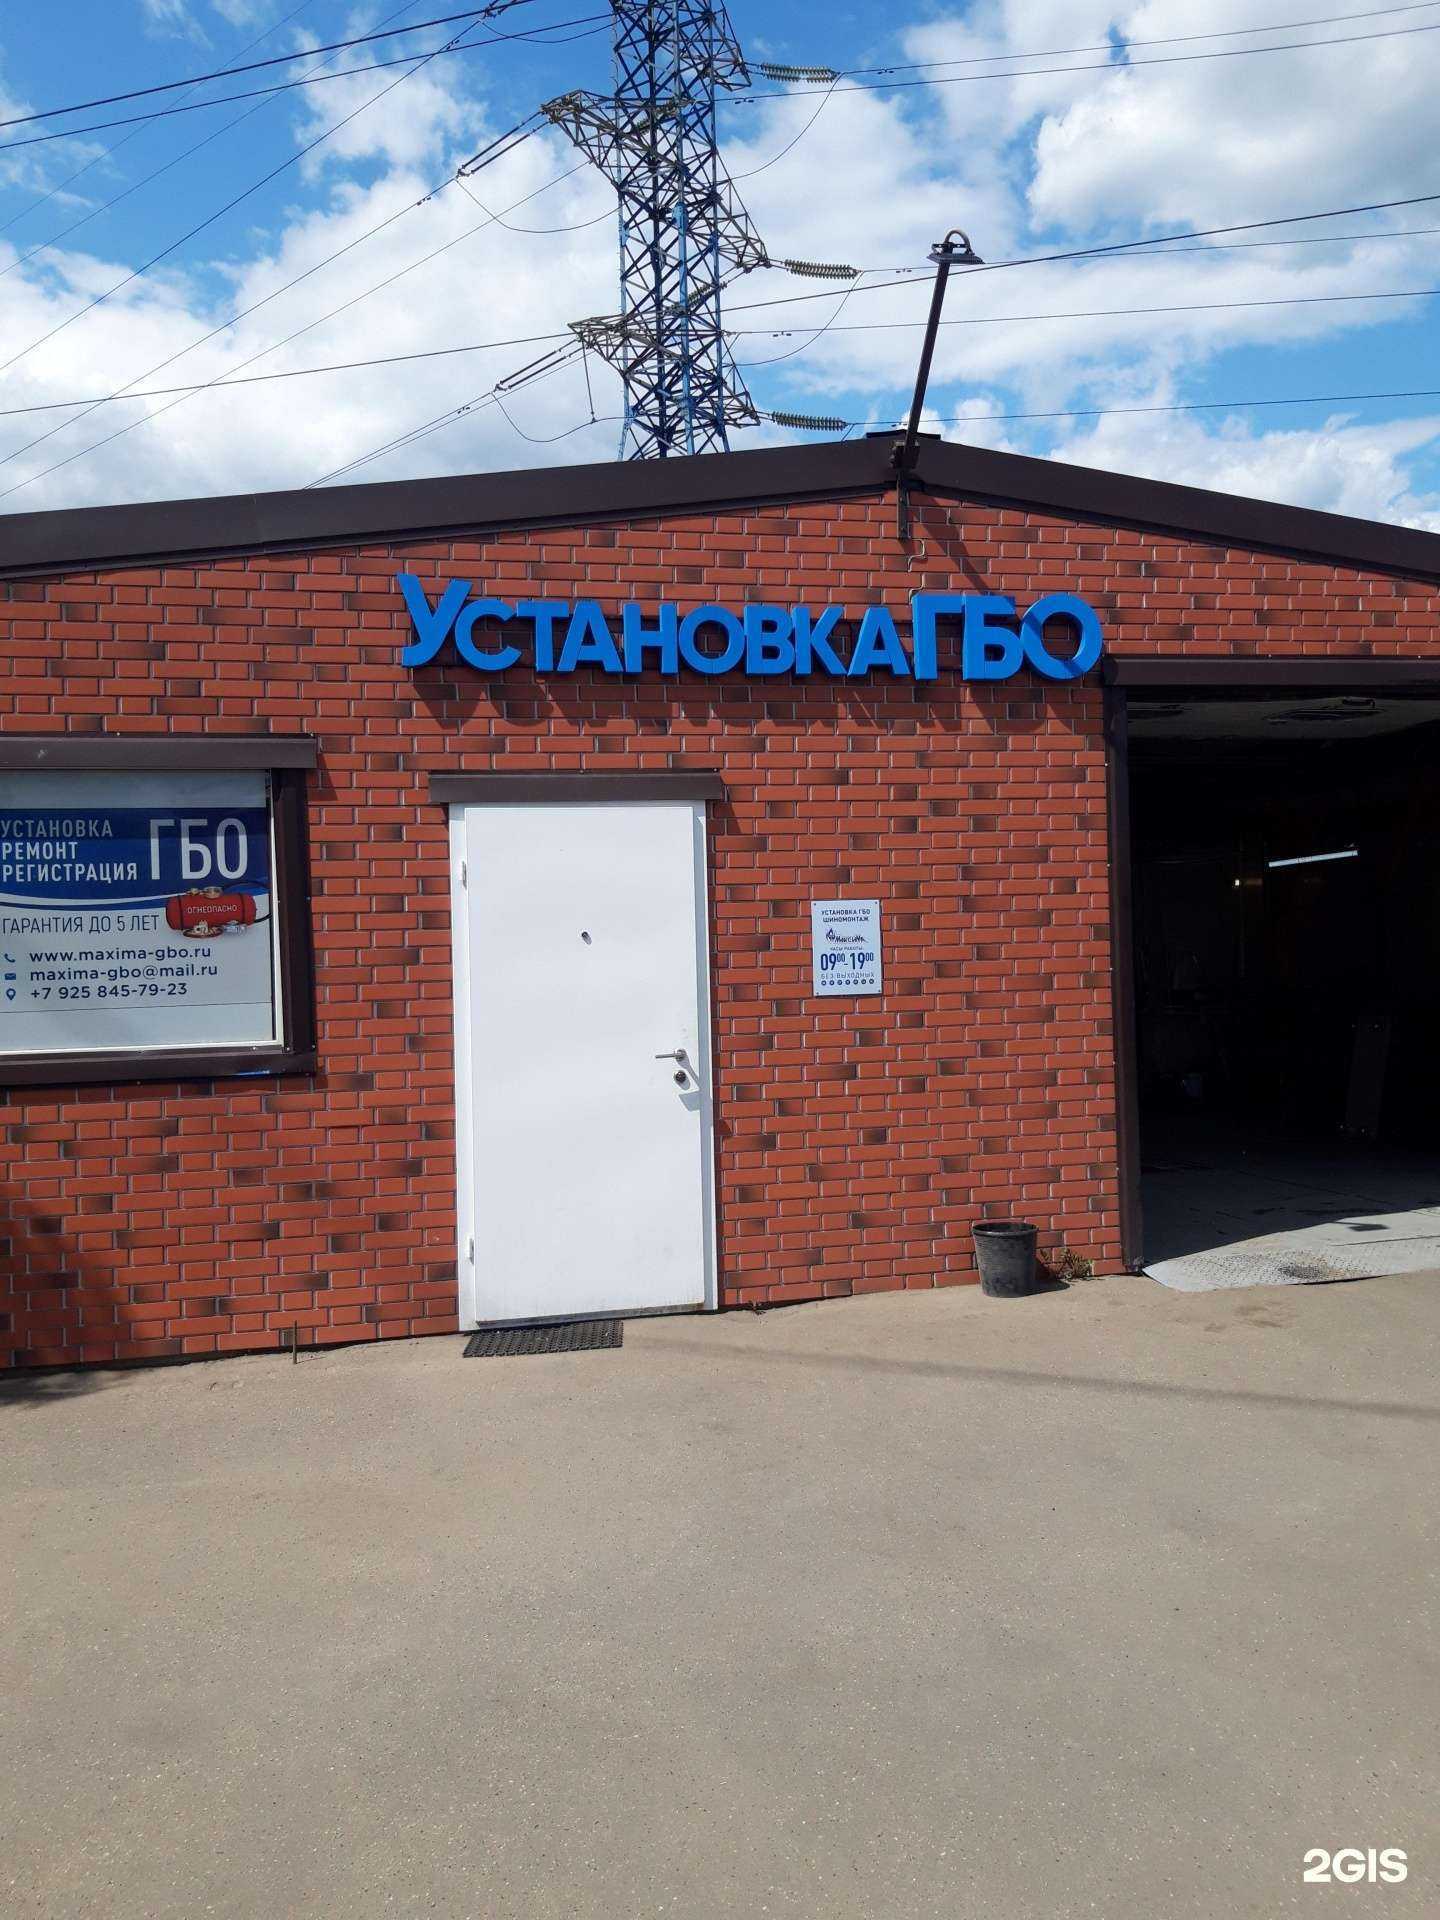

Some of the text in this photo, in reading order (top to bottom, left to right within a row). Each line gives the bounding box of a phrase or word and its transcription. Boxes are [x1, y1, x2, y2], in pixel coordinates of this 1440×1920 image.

[0, 819, 113, 838] УСТАНОВКА
[2, 842, 78, 860] РЕМОНТ
[150, 818, 248, 880] ГБО
[2, 862, 137, 883] РЕГИСТРАЦИЯ
[187, 904, 237, 914] ОГНЕОПАСНО
[2, 915, 159, 935] ГАРАНТИЯ ДО 5 ЛЕТ
[29, 947, 211, 962] www.maxima-gbo.ru
[30, 964, 217, 981] maxima-gbo@mail.ru
[31, 983, 188, 1000] +7 925 845-79-23
